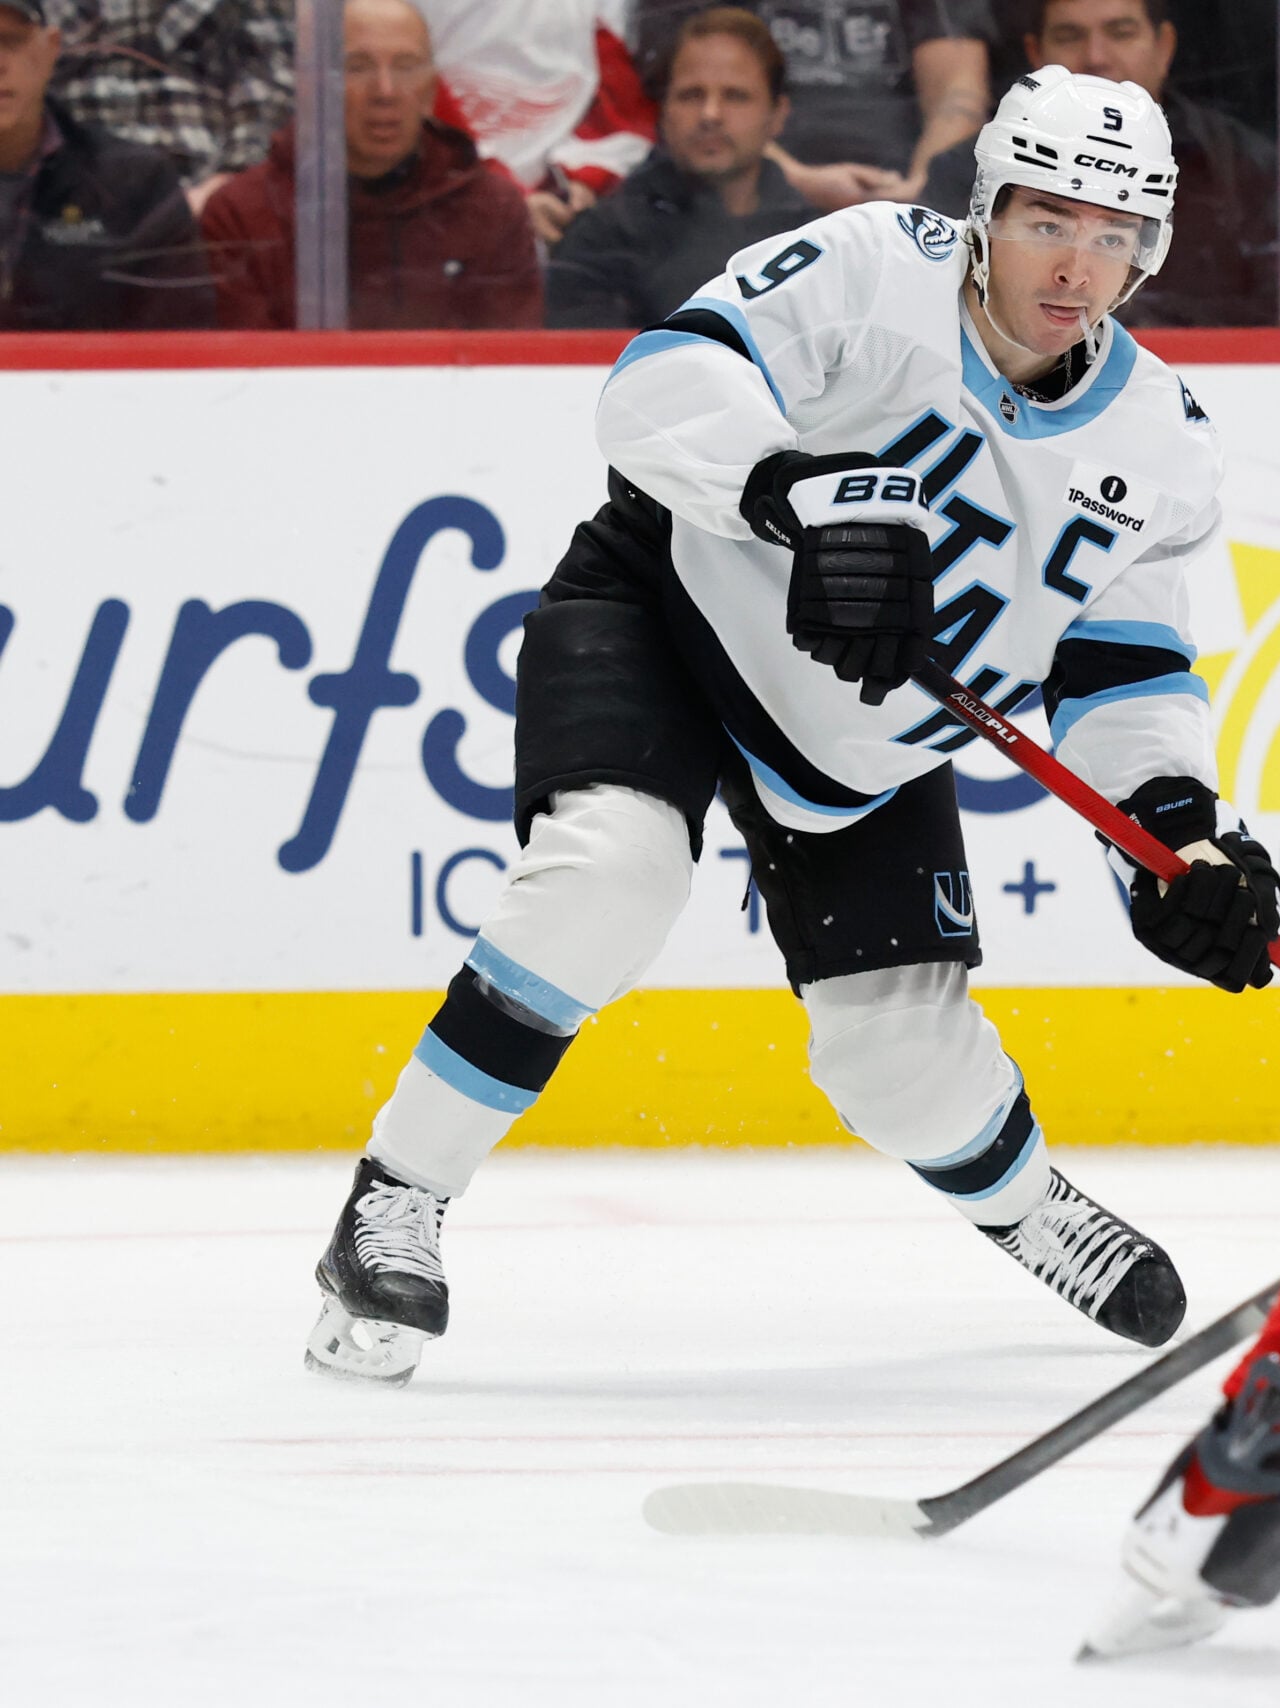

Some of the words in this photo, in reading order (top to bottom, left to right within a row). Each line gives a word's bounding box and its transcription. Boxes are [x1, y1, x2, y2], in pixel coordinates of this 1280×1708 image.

[1073, 153, 1139, 178] CCM
[736, 239, 825, 301] 9
[1068, 488, 1145, 532] 1Password
[874, 407, 1042, 753] UTAH
[1041, 513, 1120, 606] C
[410, 847, 508, 938] IC
